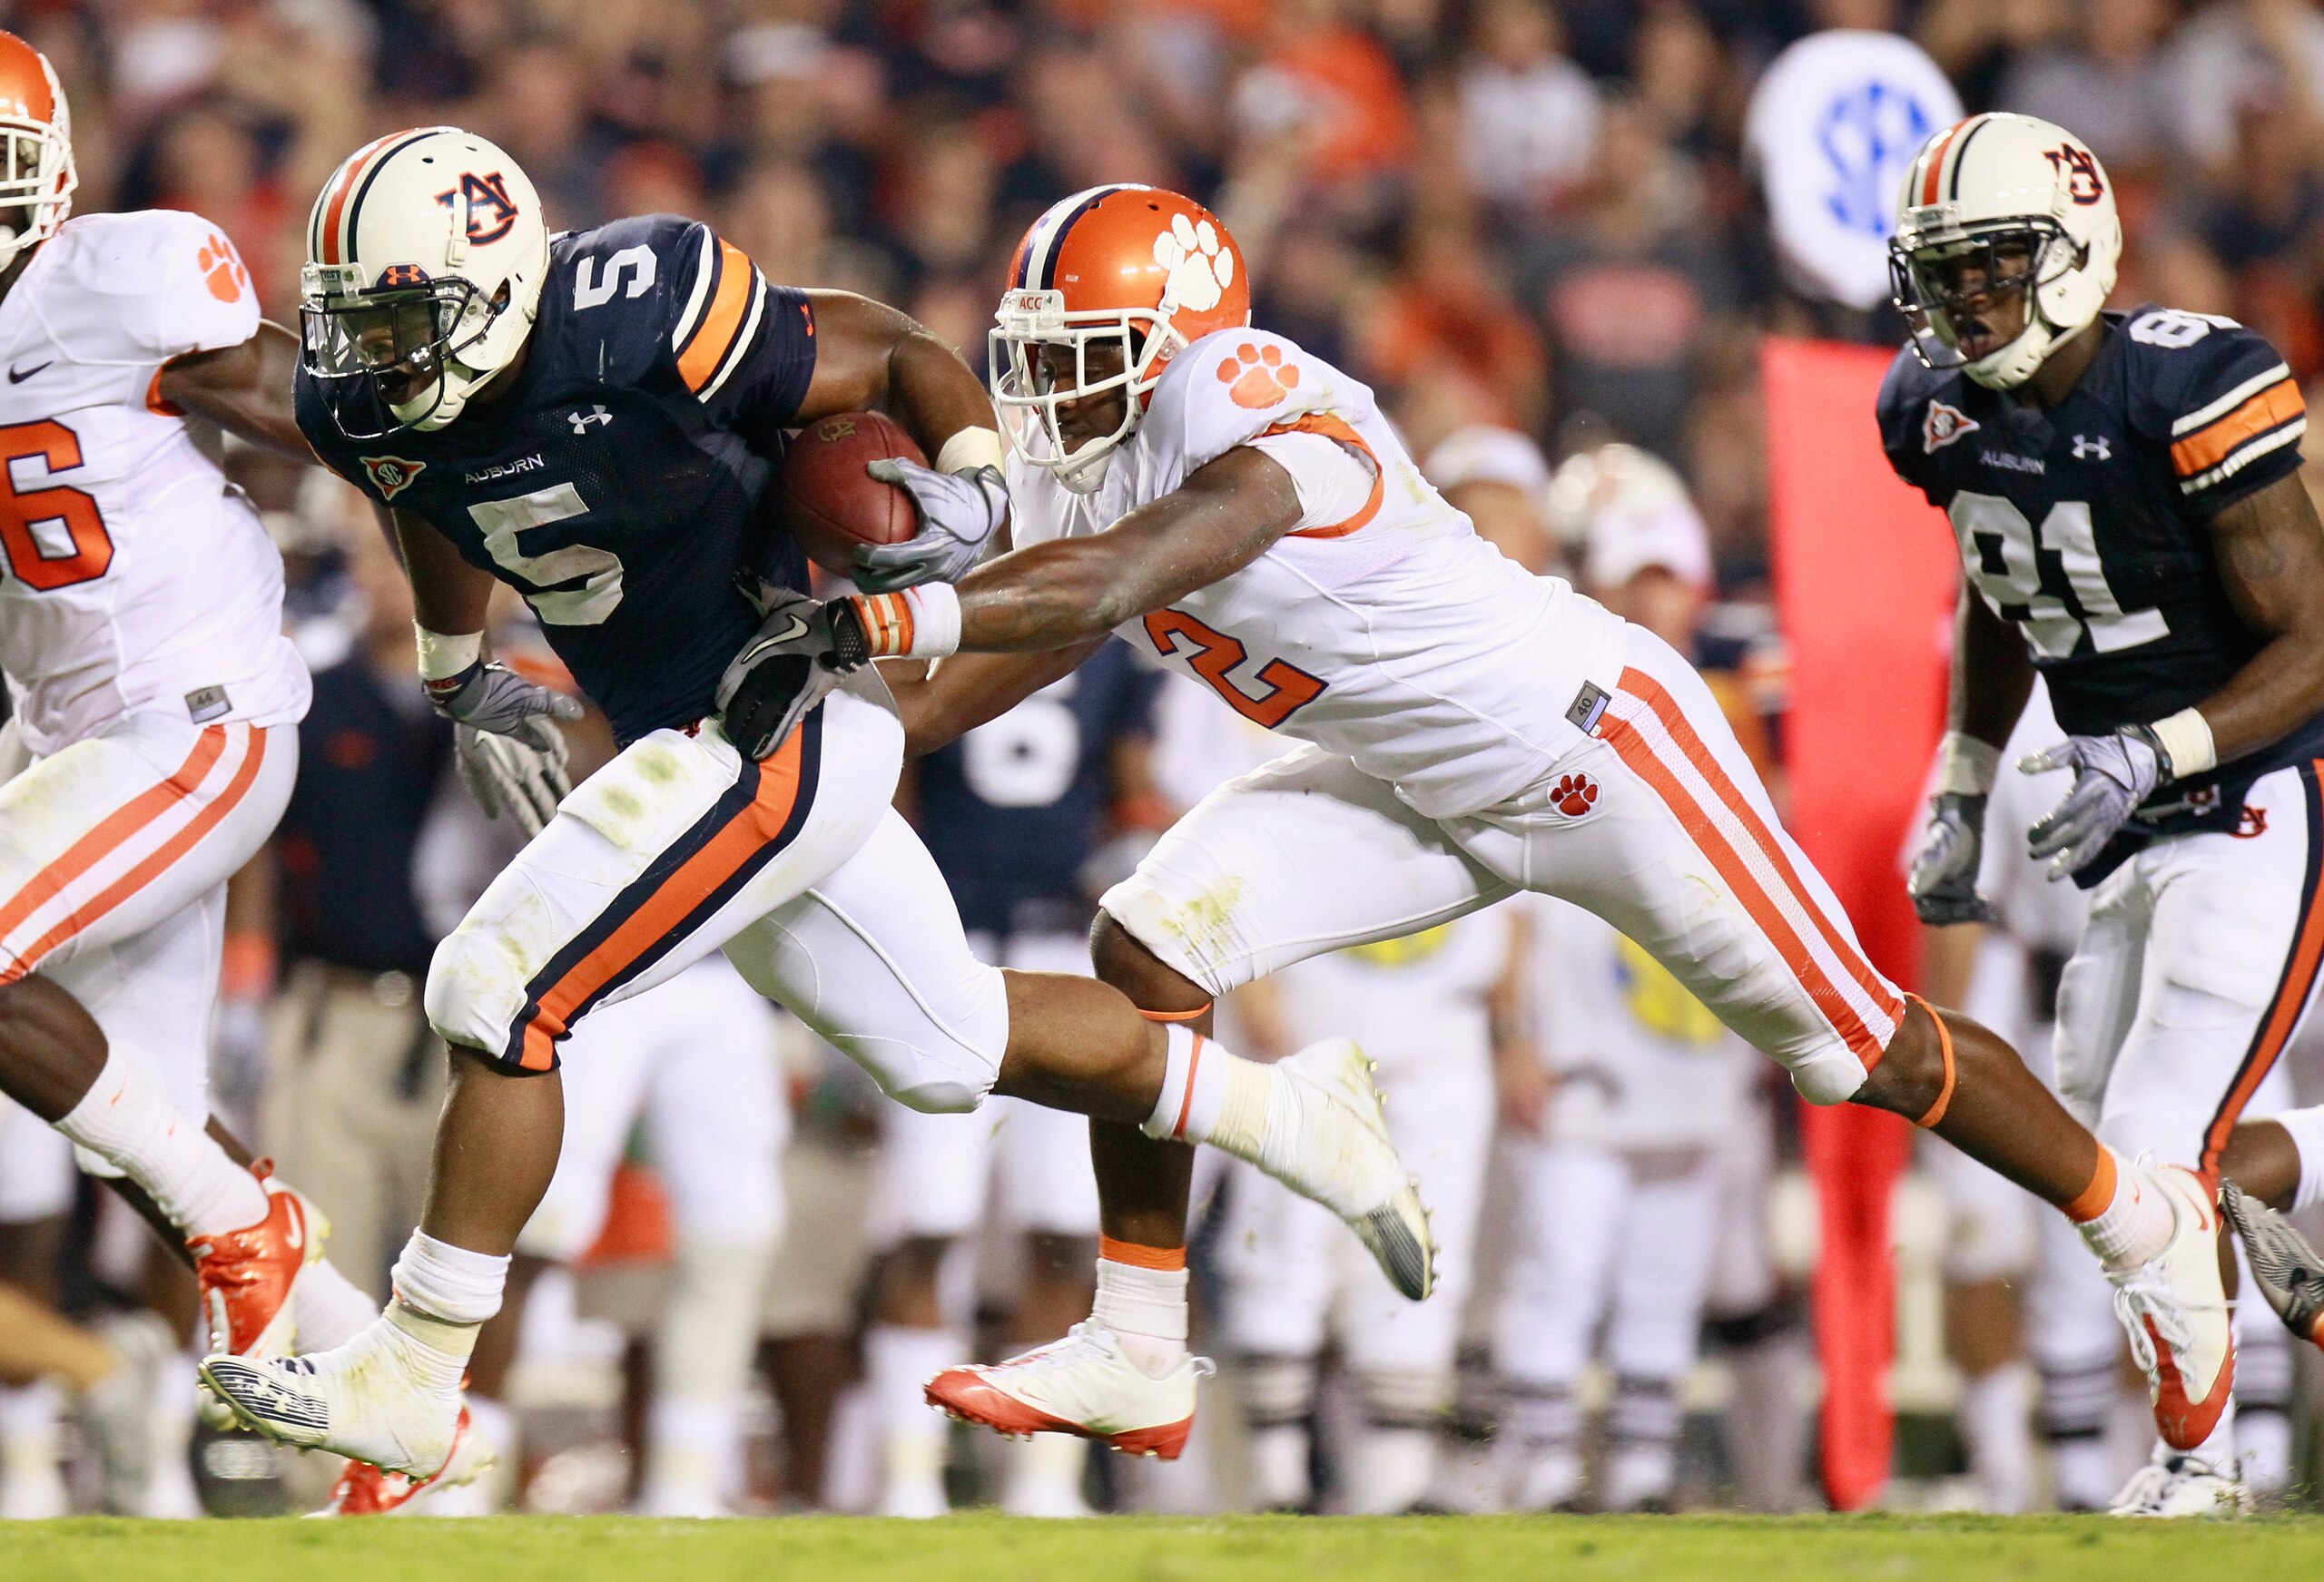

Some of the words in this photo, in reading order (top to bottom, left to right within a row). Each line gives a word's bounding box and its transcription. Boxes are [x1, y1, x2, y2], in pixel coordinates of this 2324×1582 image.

[574, 243, 658, 311] 5
[1019, 296, 1043, 310] ACC
[2129, 309, 2243, 349] 81
[378, 462, 402, 486] SEC
[465, 453, 546, 484] AUBURN
[467, 482, 625, 626] 5
[1948, 489, 2171, 654] 81
[1143, 607, 1330, 731] 2
[1577, 698, 1593, 717] 40
